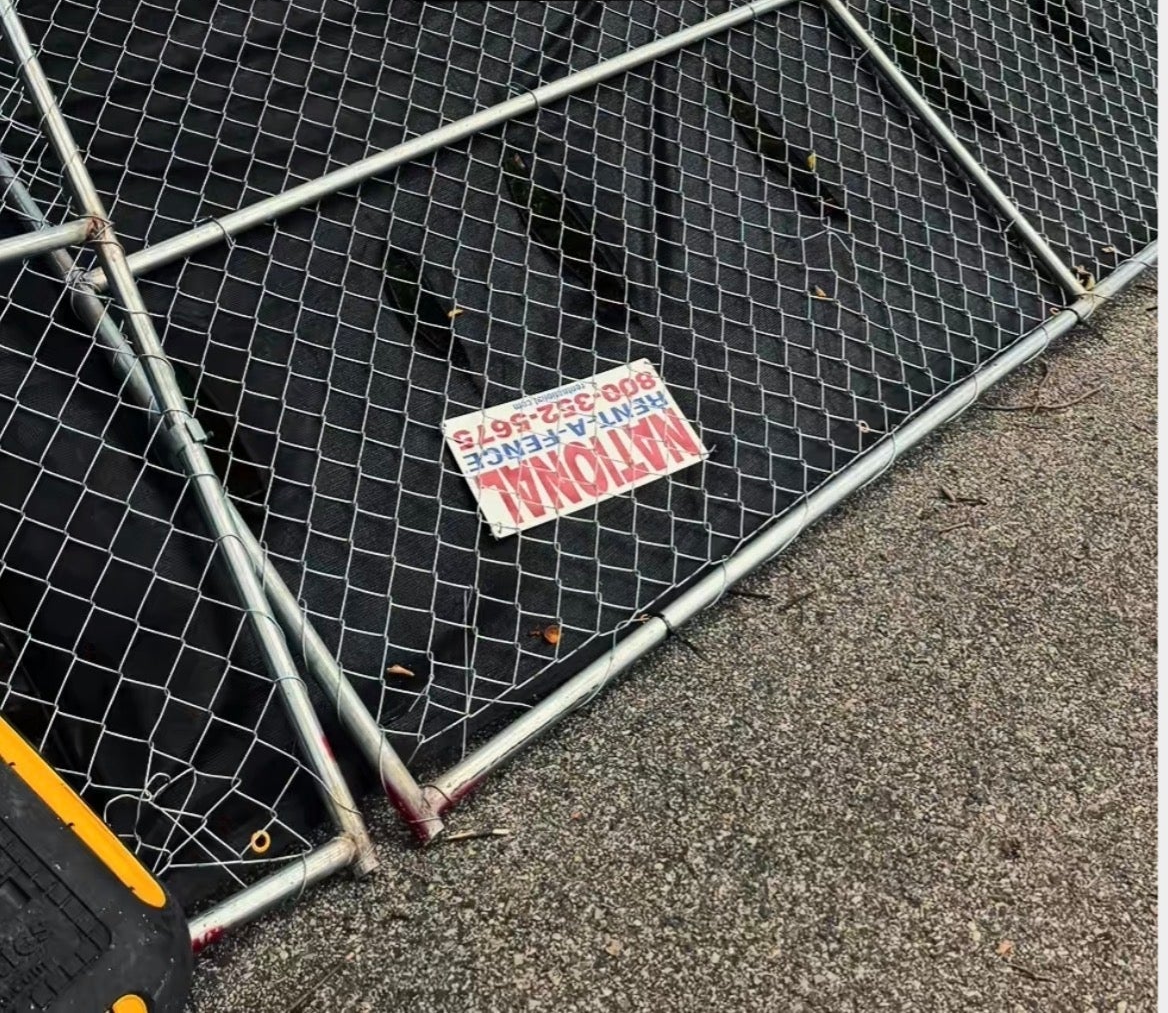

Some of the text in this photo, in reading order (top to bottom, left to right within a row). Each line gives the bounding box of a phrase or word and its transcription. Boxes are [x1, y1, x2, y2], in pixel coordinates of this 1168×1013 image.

[453, 371, 656, 451] 800-352-5675
[463, 390, 669, 473] RENT-A-FENCE
[474, 408, 701, 524] NATIONAL
